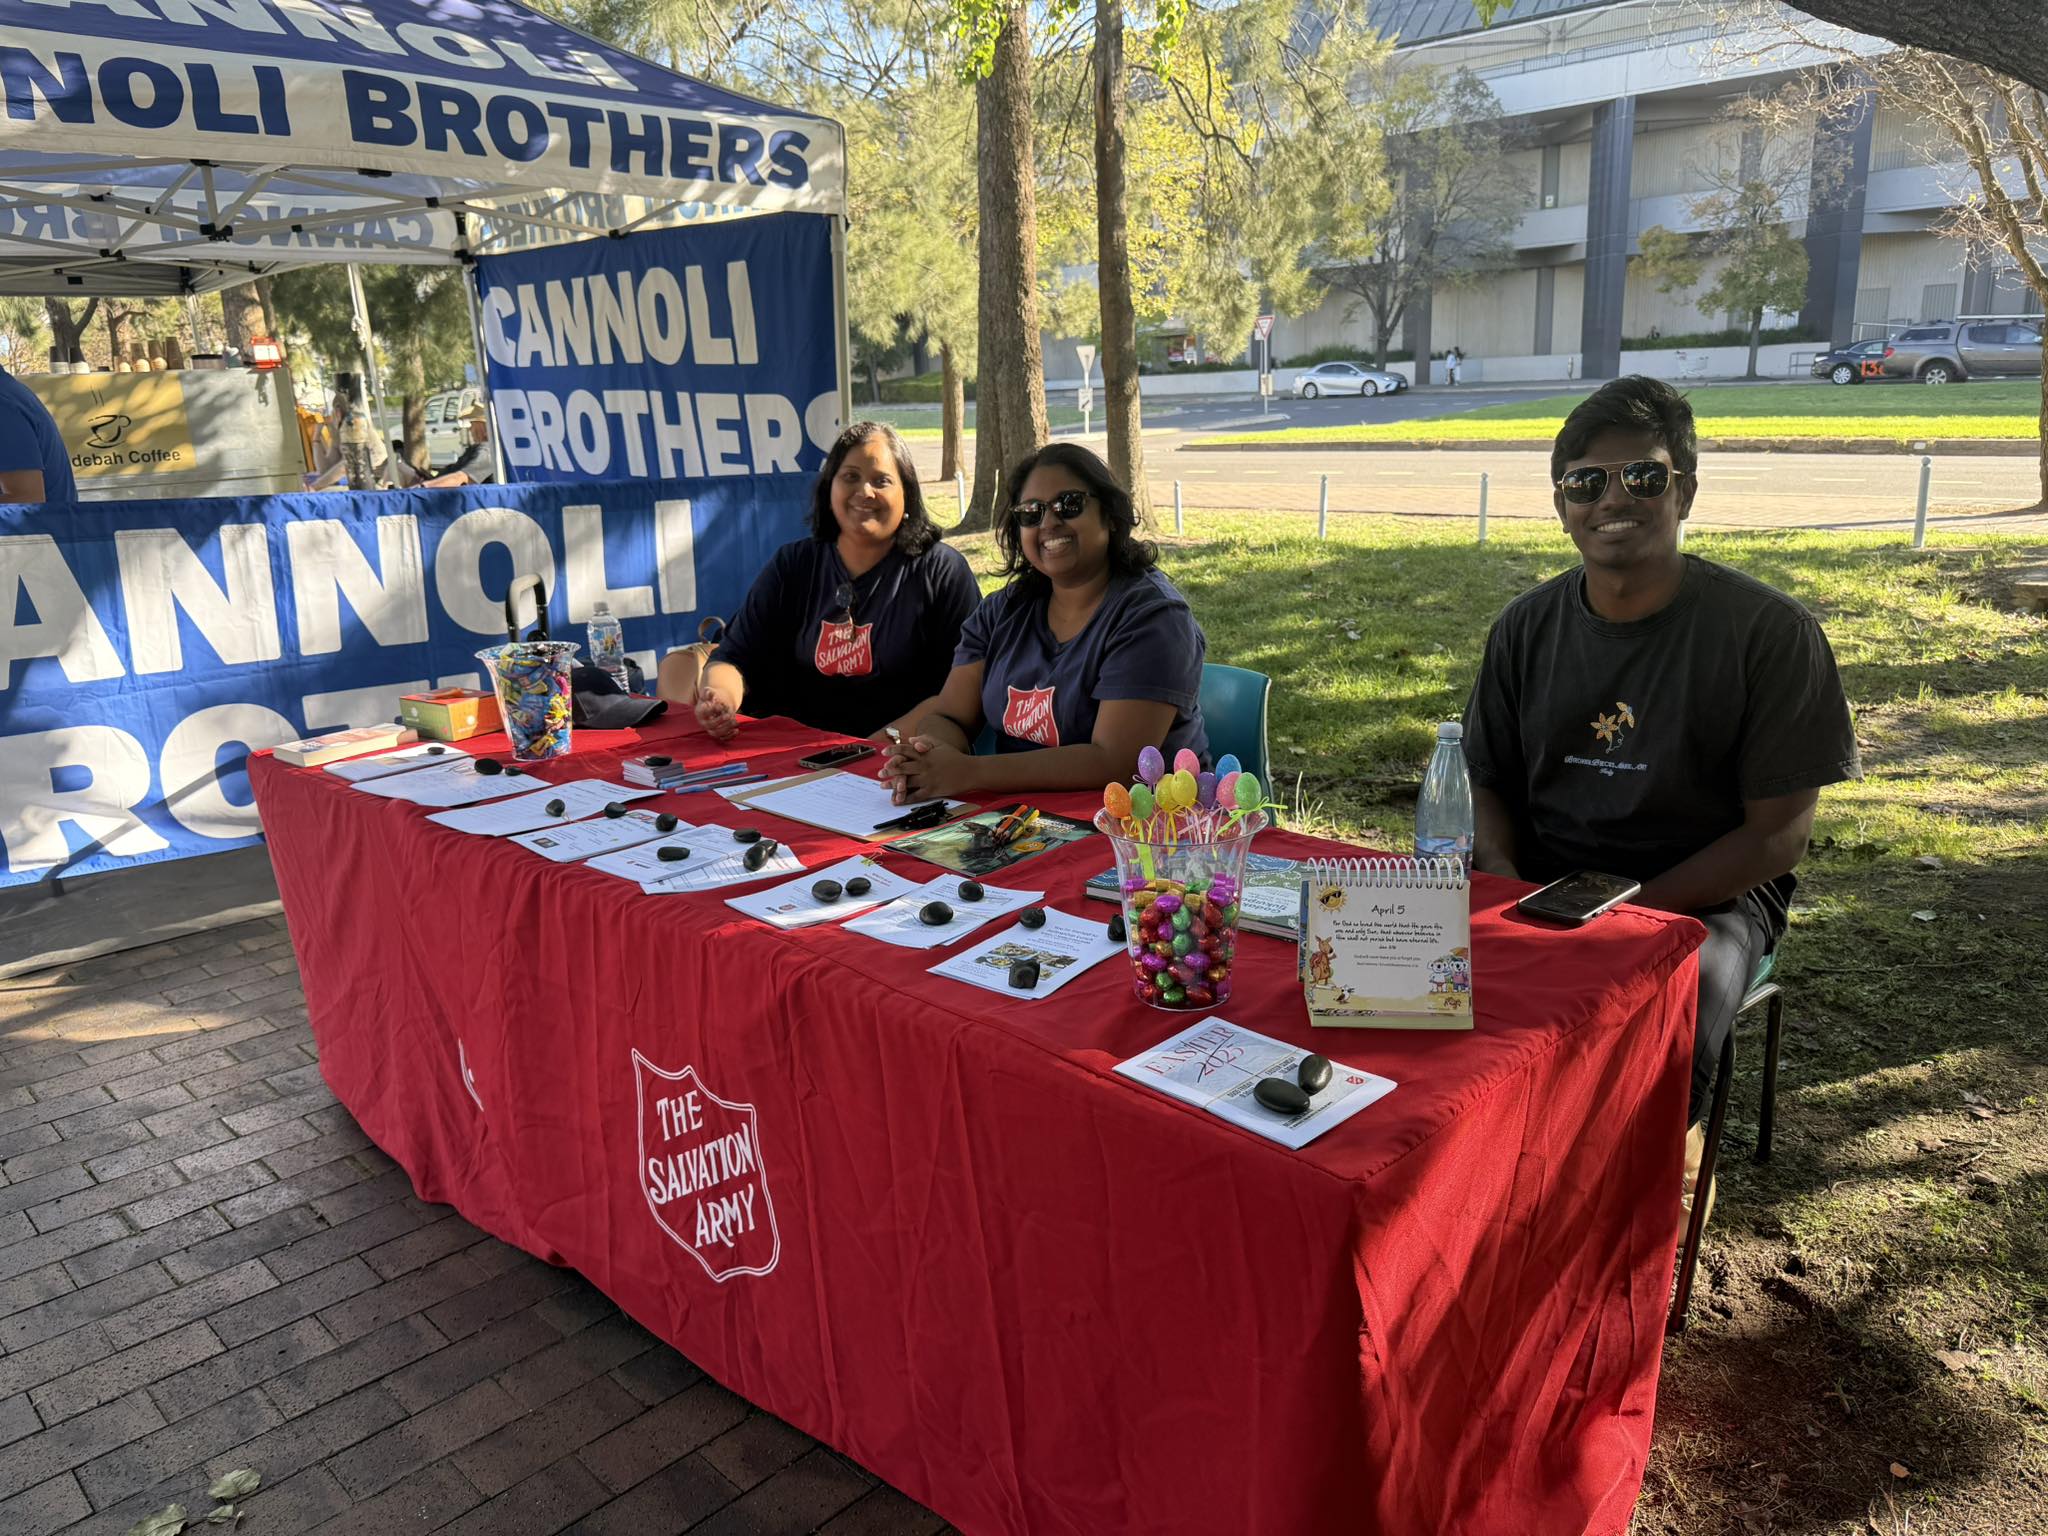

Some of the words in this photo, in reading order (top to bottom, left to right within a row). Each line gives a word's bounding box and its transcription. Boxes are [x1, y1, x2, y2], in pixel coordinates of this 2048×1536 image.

[0, 45, 291, 137] NOLI
[342, 69, 811, 190] BROTHERS
[482, 260, 760, 368] CANNOLI
[128, 449, 181, 464] Coffee
[818, 628, 869, 670] SALVATION
[827, 626, 853, 647] THE
[836, 649, 865, 674] ARMY
[1007, 694, 1049, 737] SALVATION
[1015, 692, 1036, 718] THE
[1371, 903, 1394, 917] April
[1397, 904, 1406, 915] 5
[1144, 1025, 1235, 1076] EASTER
[1197, 1043, 1245, 1077] 2025
[656, 1090, 703, 1141] THE
[648, 1122, 756, 1205] SALVATION
[695, 1183, 755, 1248] ARMY
